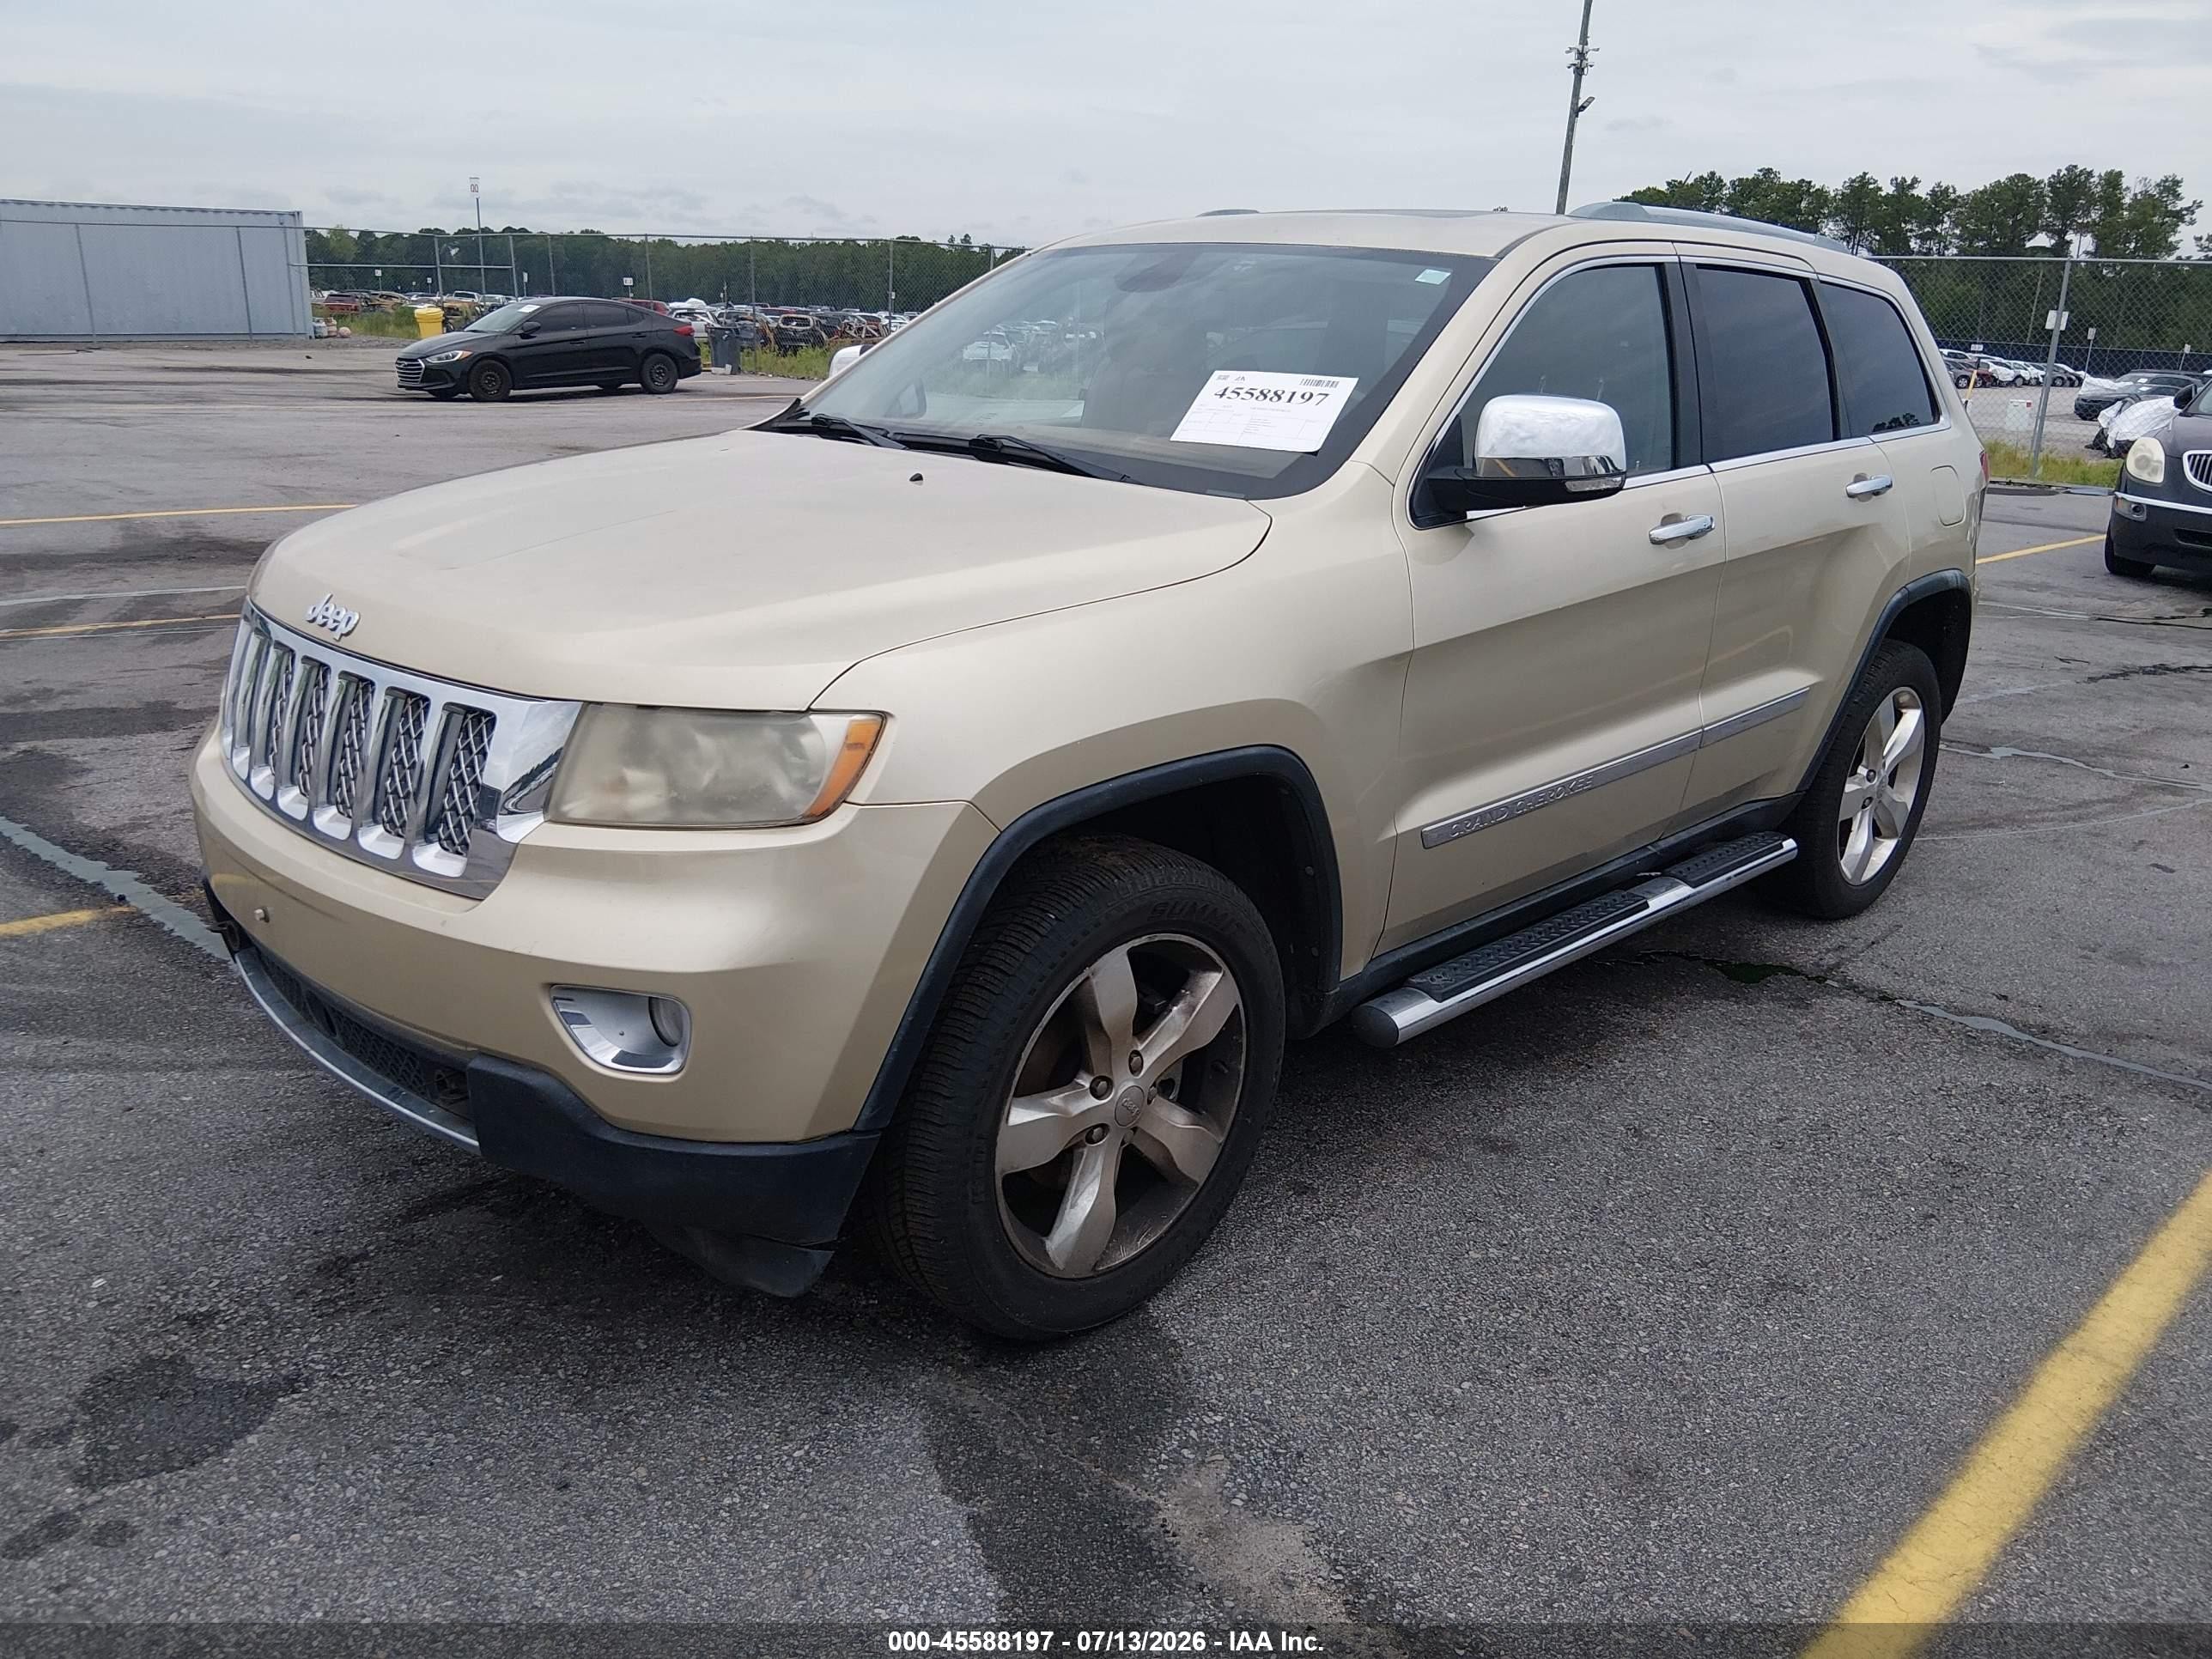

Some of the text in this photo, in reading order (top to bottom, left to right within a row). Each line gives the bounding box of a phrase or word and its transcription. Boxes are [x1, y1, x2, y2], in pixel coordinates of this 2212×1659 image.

[1214, 386, 1331, 406] 45588197
[306, 593, 361, 642] Jeep
[1449, 775, 1595, 838] GRAND CHEROKEE
